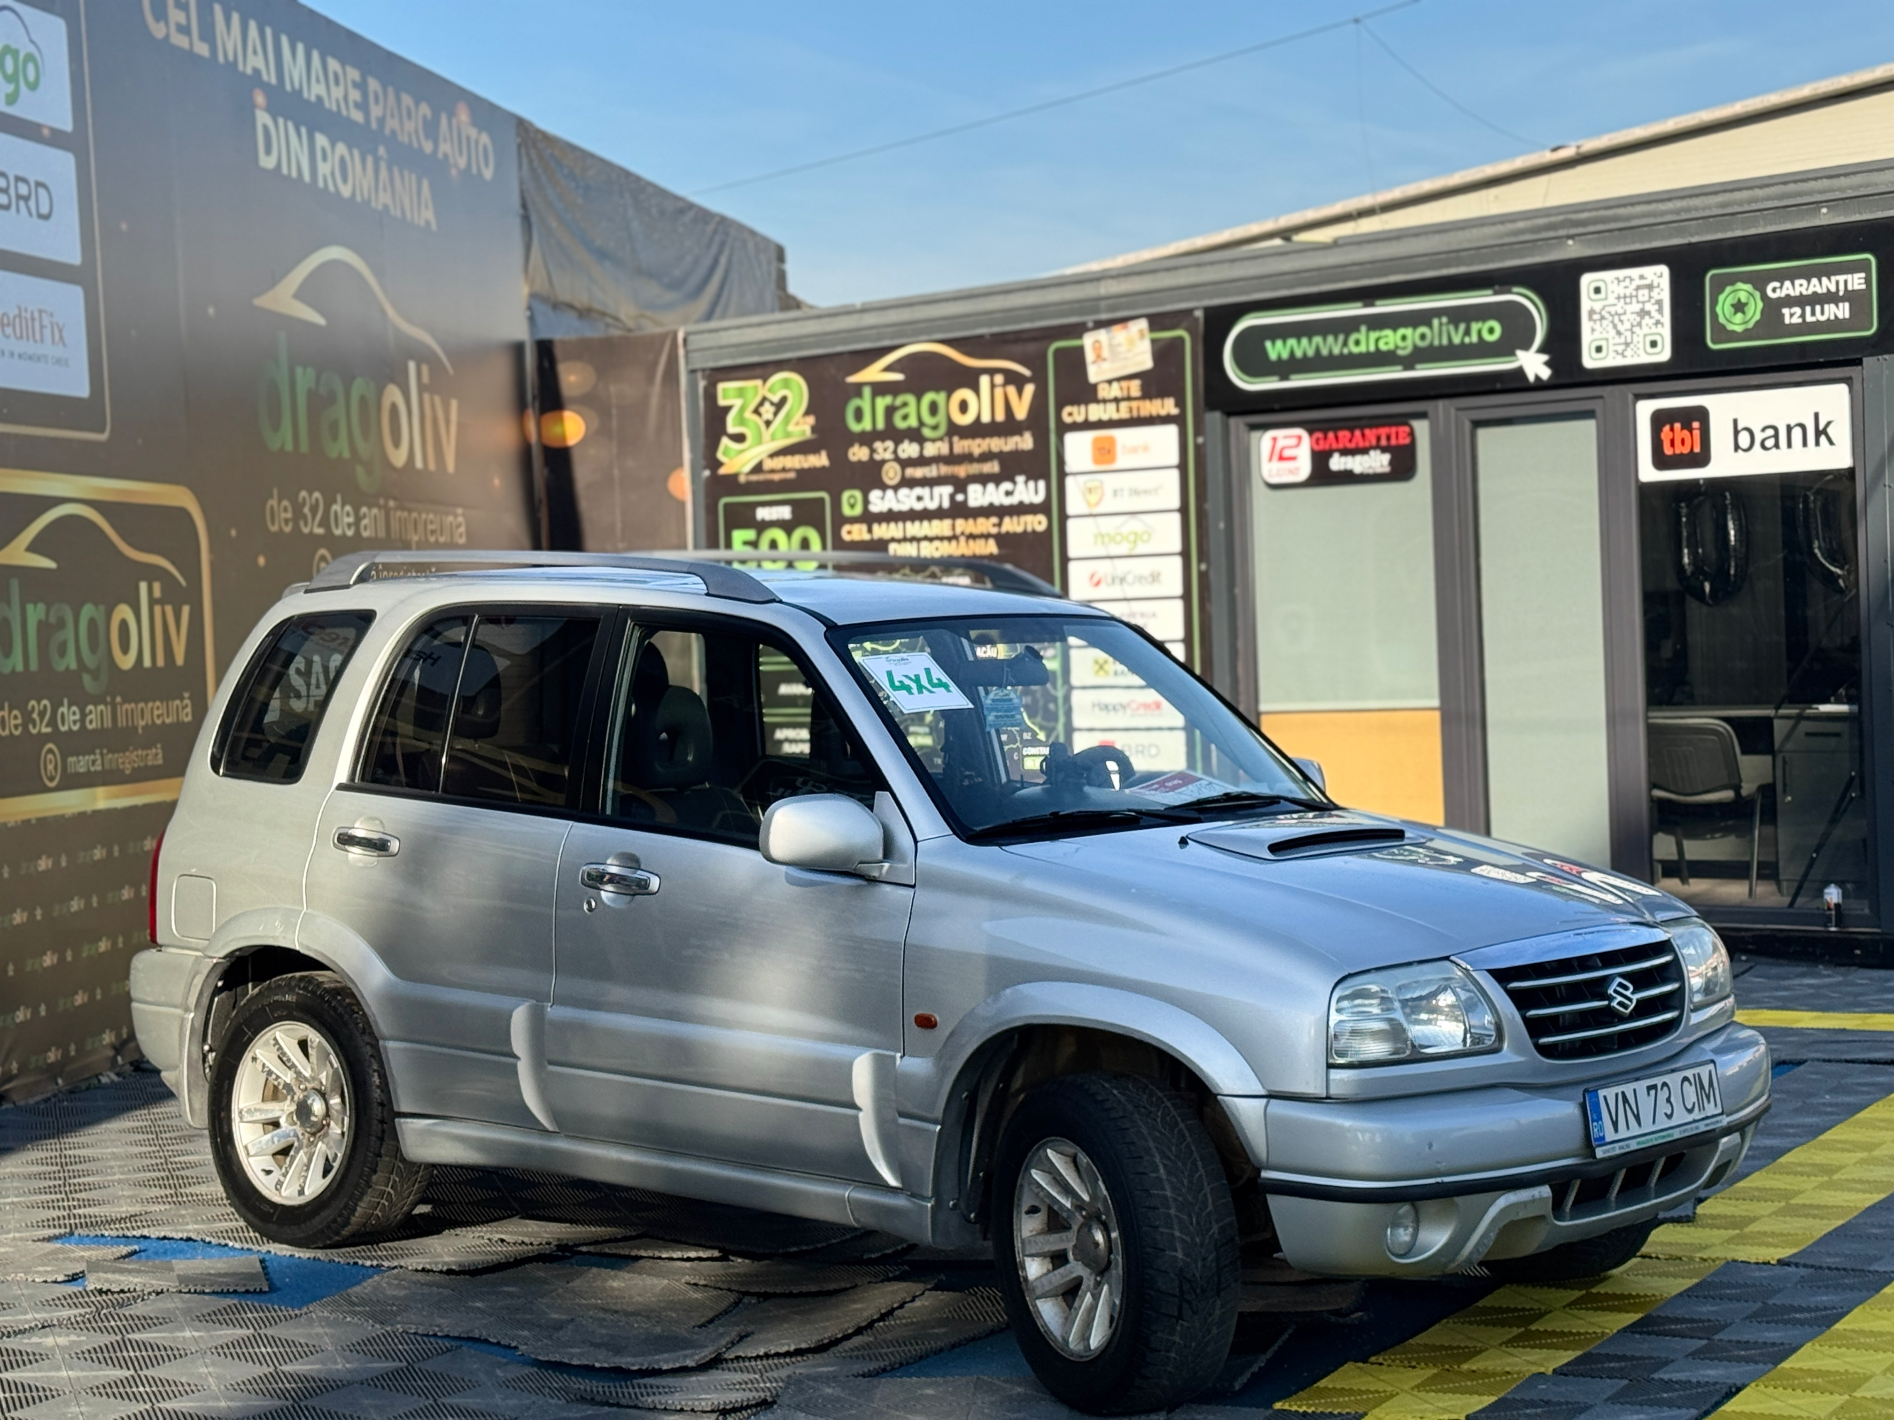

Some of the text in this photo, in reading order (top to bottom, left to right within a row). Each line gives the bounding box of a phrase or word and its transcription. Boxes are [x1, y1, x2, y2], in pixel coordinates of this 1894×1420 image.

[213, 2, 277, 86] MAI
[280, 33, 365, 125] MARE
[367, 75, 434, 155] PARC
[437, 110, 494, 181] AUTO
[254, 108, 437, 231] DIN ROMÂNIA
[1781, 302, 1850, 324] 12 LUNI
[1264, 316, 1501, 361] www.dragoliv.ro
[845, 373, 1036, 440] dragoliv
[1061, 397, 1180, 423] CU BULETINUL
[1097, 379, 1142, 400] RATE
[256, 331, 459, 494] dragoliv
[716, 371, 809, 466] 32
[1660, 411, 1836, 456] tbi bank
[847, 443, 870, 462] de
[873, 440, 895, 461] 32
[897, 439, 920, 459] de
[922, 436, 950, 458] ani
[1268, 425, 1412, 463] 12 GARANTIE
[1328, 449, 1391, 474] dragoliv
[868, 485, 954, 513] SASCUT
[967, 475, 1046, 508] BACĂU
[265, 487, 467, 550] de 32 de ani împreună
[841, 513, 1048, 541] CEL MAI MARE PARC AUTO
[731, 526, 823, 571] 500
[888, 535, 999, 559] DIN ROMÂNIA
[0, 577, 190, 695] dragoliv
[0, 692, 193, 736] de 32 de ani împreună
[67, 749, 102, 774] marcă
[1602, 1069, 1718, 1134] VN 73 CIM
[1592, 1121, 1604, 1139] RO
